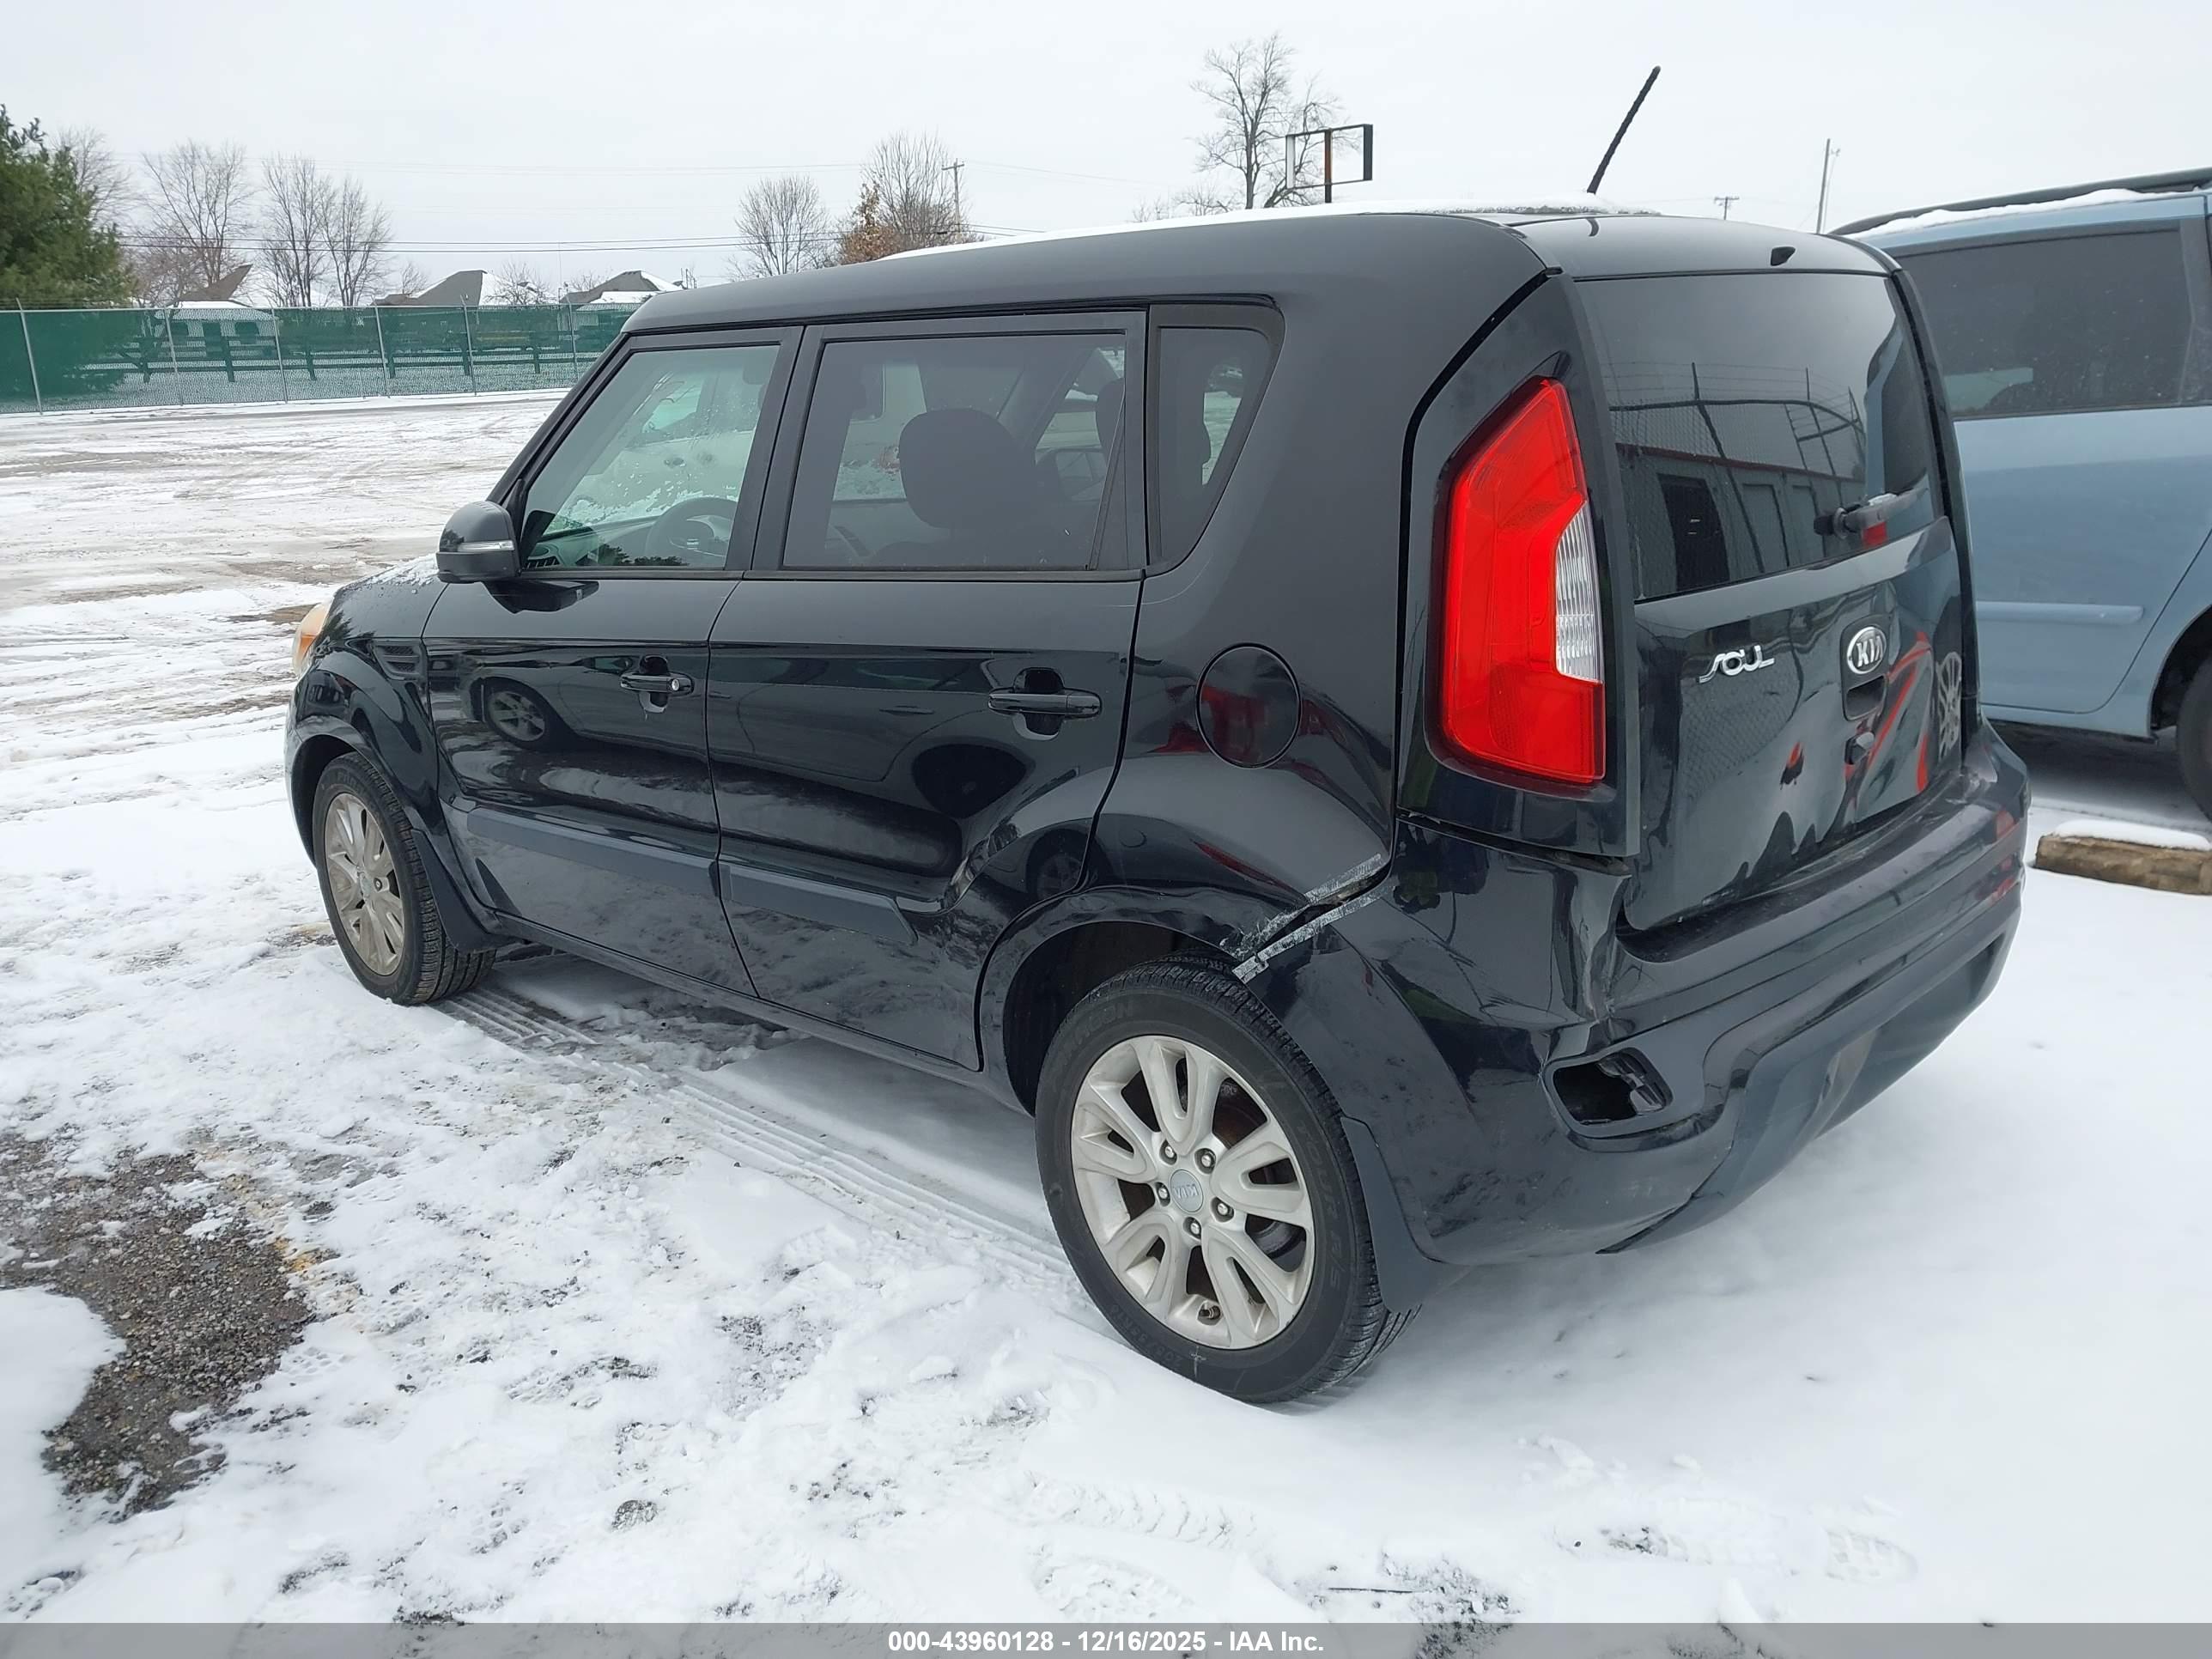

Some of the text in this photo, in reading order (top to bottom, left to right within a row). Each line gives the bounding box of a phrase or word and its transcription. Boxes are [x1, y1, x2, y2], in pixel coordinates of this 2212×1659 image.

[1697, 645, 1776, 684] SOUL
[1855, 635, 1886, 668] KIA
[1172, 1186, 1200, 1200] KIA
